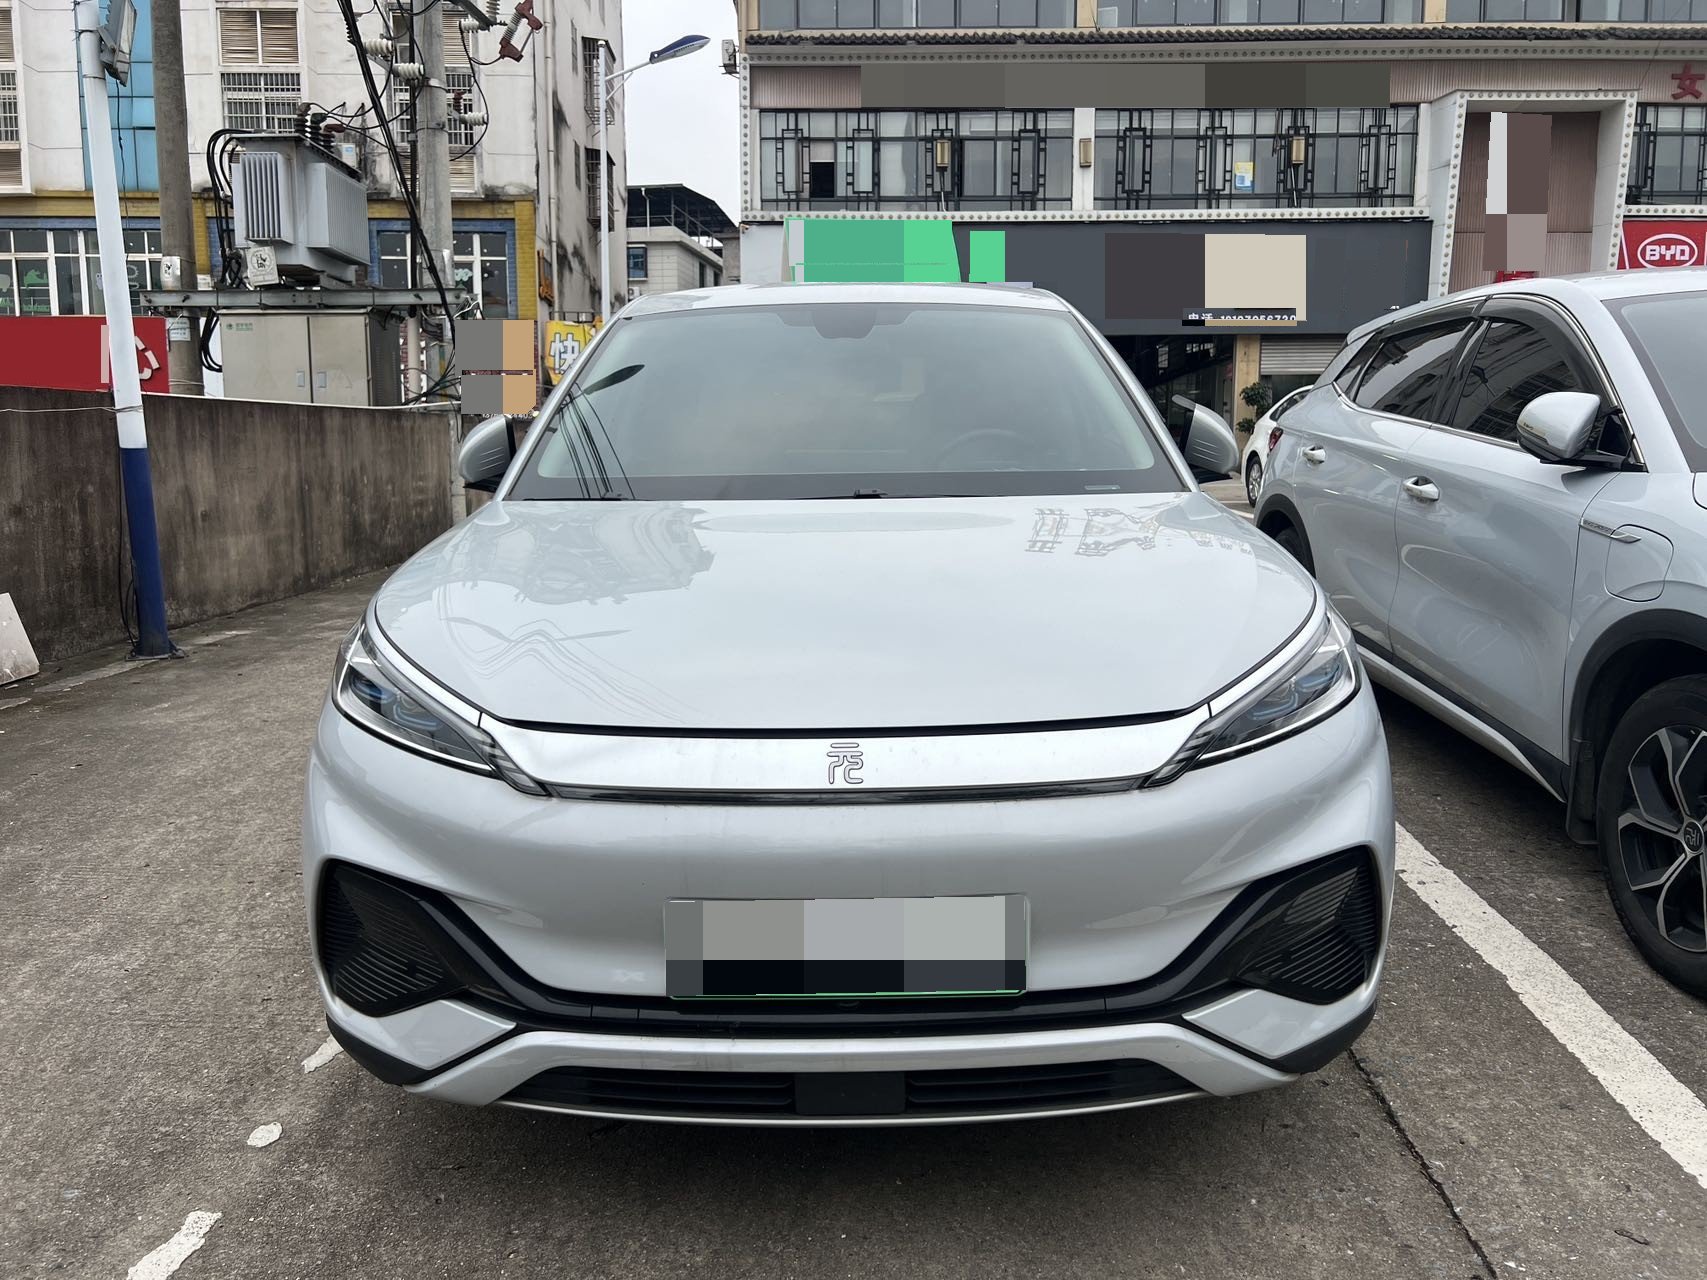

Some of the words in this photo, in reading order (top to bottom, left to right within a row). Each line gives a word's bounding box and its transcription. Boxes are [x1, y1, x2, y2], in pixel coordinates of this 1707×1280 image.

[1671, 63, 1706, 100] 女
[1645, 245, 1690, 261] BYD
[549, 332, 580, 376] 快
